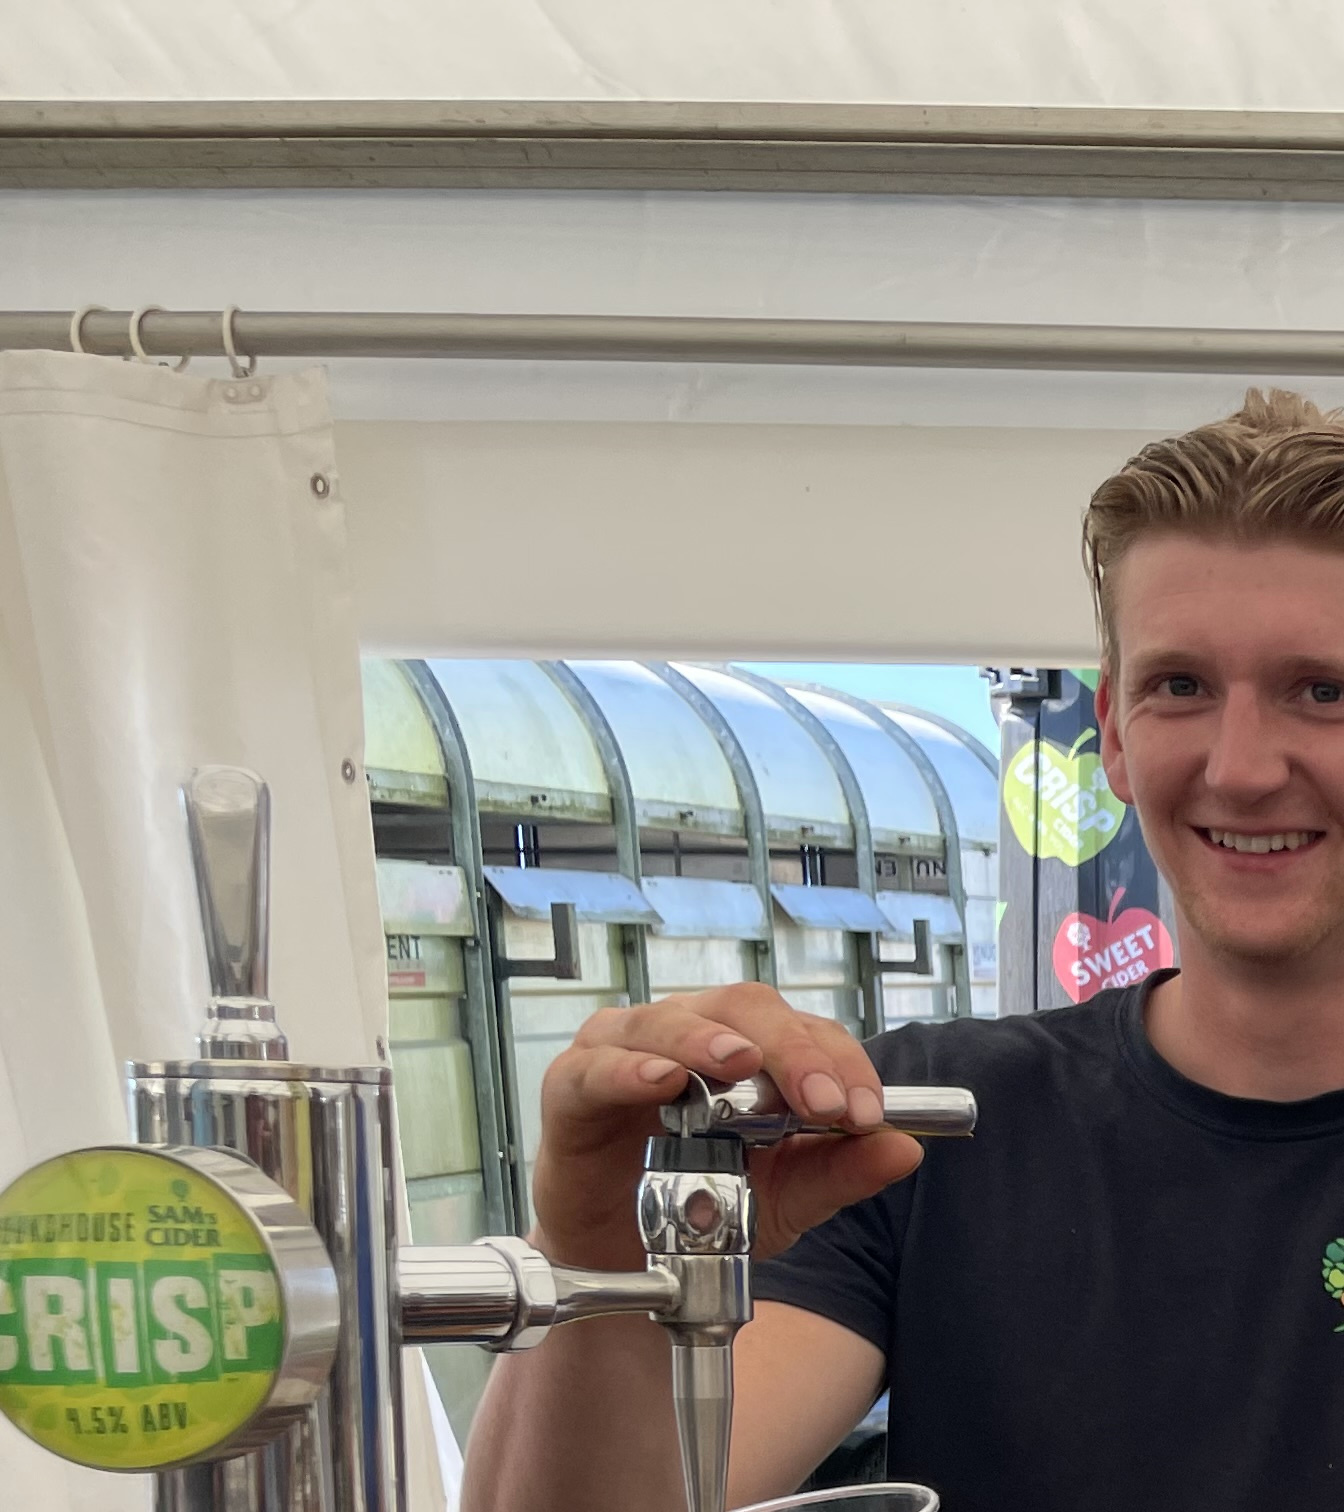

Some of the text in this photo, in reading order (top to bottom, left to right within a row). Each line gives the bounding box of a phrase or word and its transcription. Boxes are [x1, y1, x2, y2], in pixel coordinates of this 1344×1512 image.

[1014, 753, 1115, 832] CRISP
[1071, 924, 1155, 986] SWEET
[145, 1227, 221, 1247] CIDER
[141, 1402, 187, 1432] ABV
